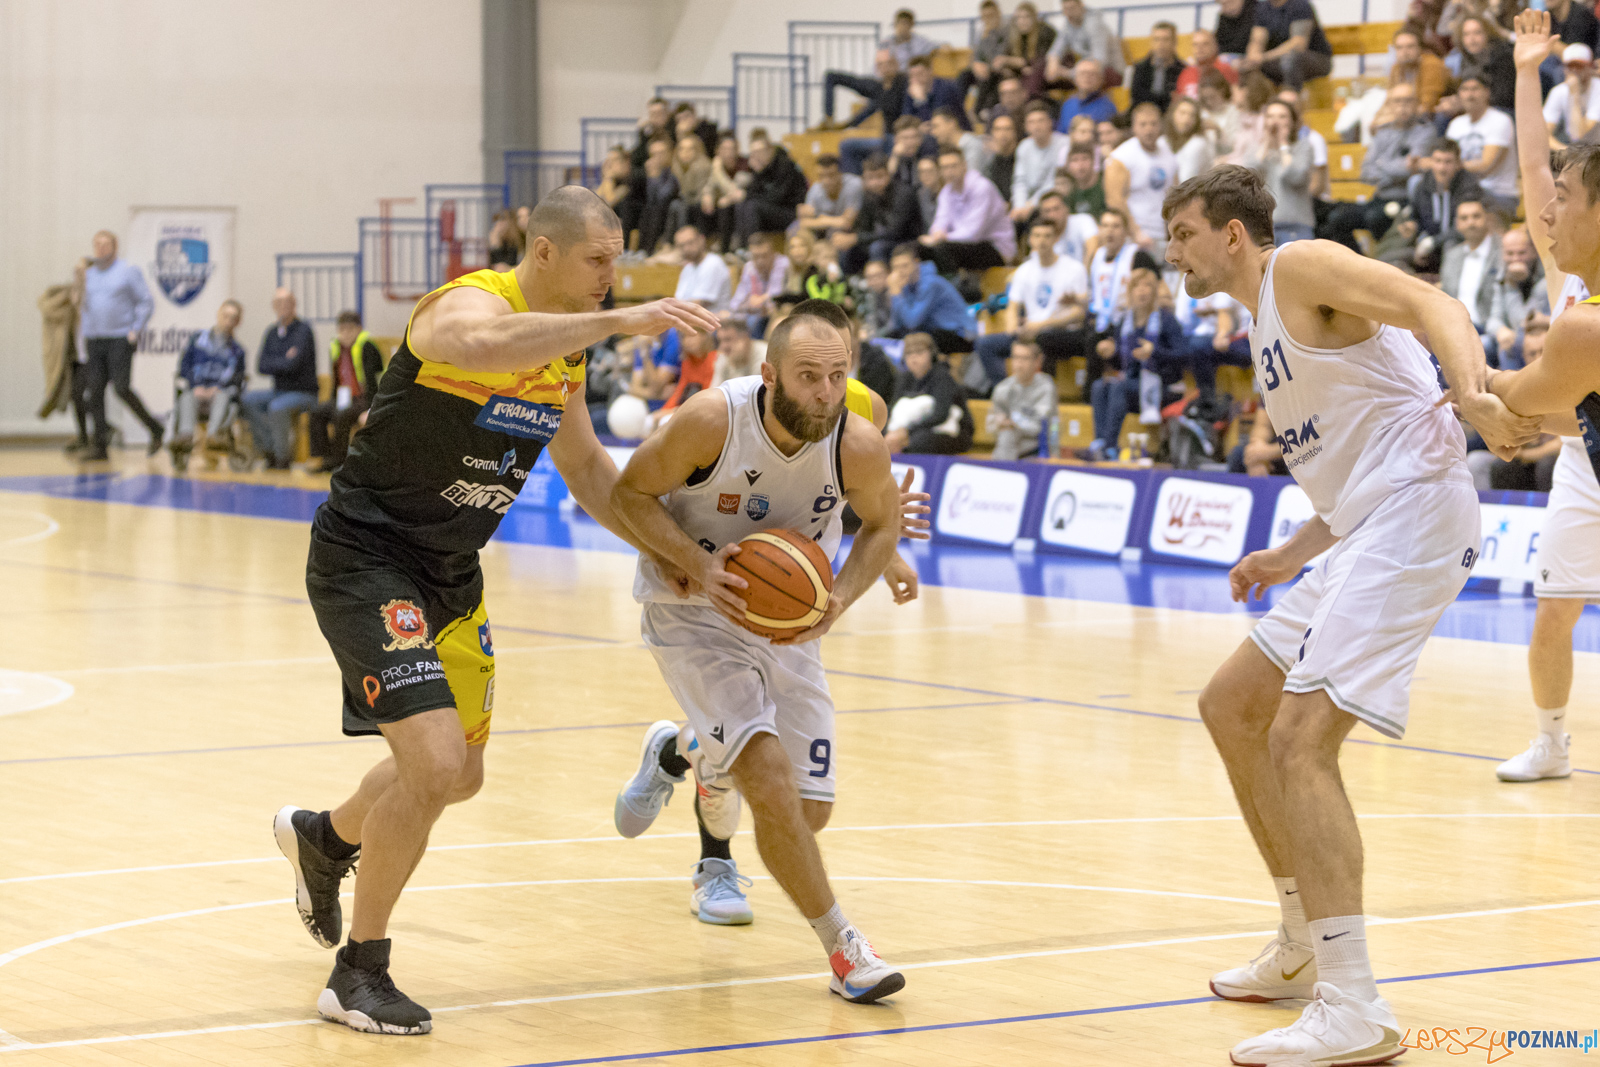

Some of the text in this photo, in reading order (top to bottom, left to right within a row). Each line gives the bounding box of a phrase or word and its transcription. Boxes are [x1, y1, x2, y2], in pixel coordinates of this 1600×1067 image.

[1261, 338, 1293, 391] 31
[462, 455, 499, 471] CAPITAL
[823, 484, 834, 495] C
[386, 675, 423, 691] PARTNER
[809, 738, 831, 778] 9
